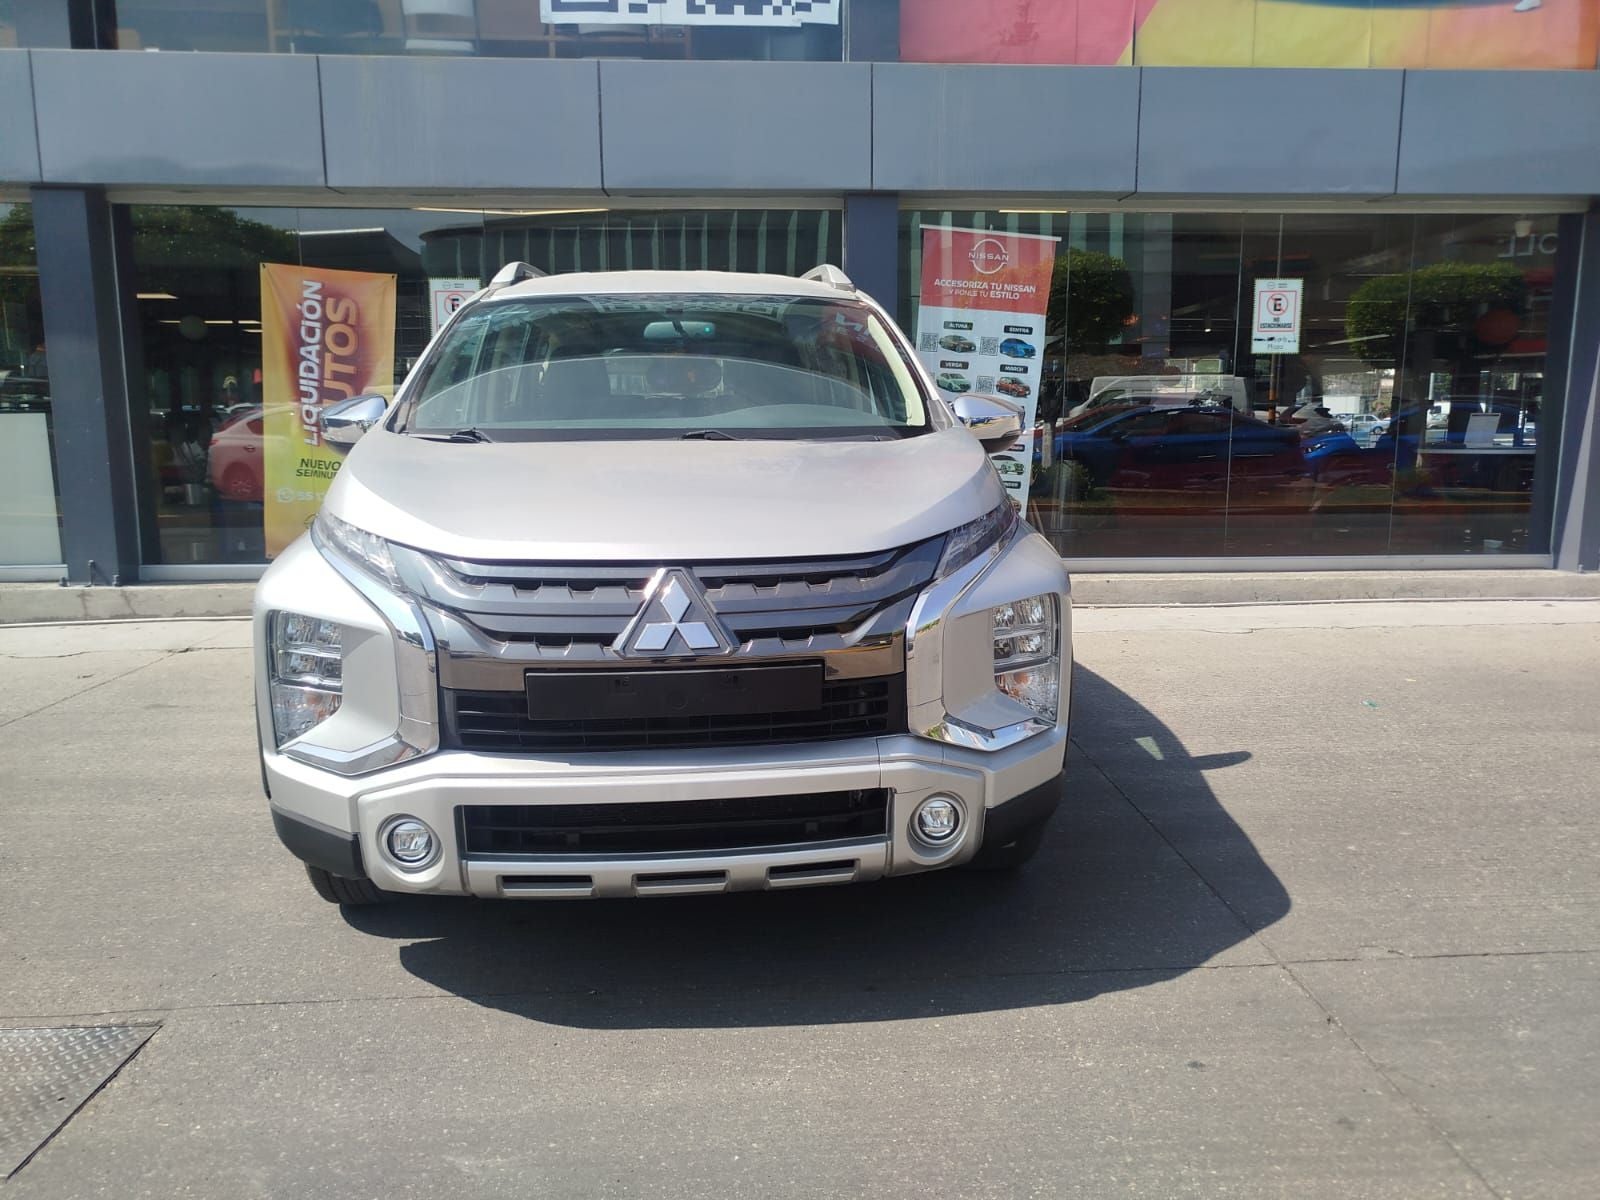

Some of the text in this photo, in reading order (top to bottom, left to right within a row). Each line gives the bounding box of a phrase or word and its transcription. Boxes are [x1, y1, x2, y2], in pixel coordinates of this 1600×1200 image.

[968, 252, 1009, 261] NISSAN
[934, 279, 1036, 294] ACCESORIZA TU NISSAN
[979, 290, 988, 298] TU
[990, 290, 1020, 300] ESTILO
[296, 280, 323, 447] LIQUIDACIÓN
